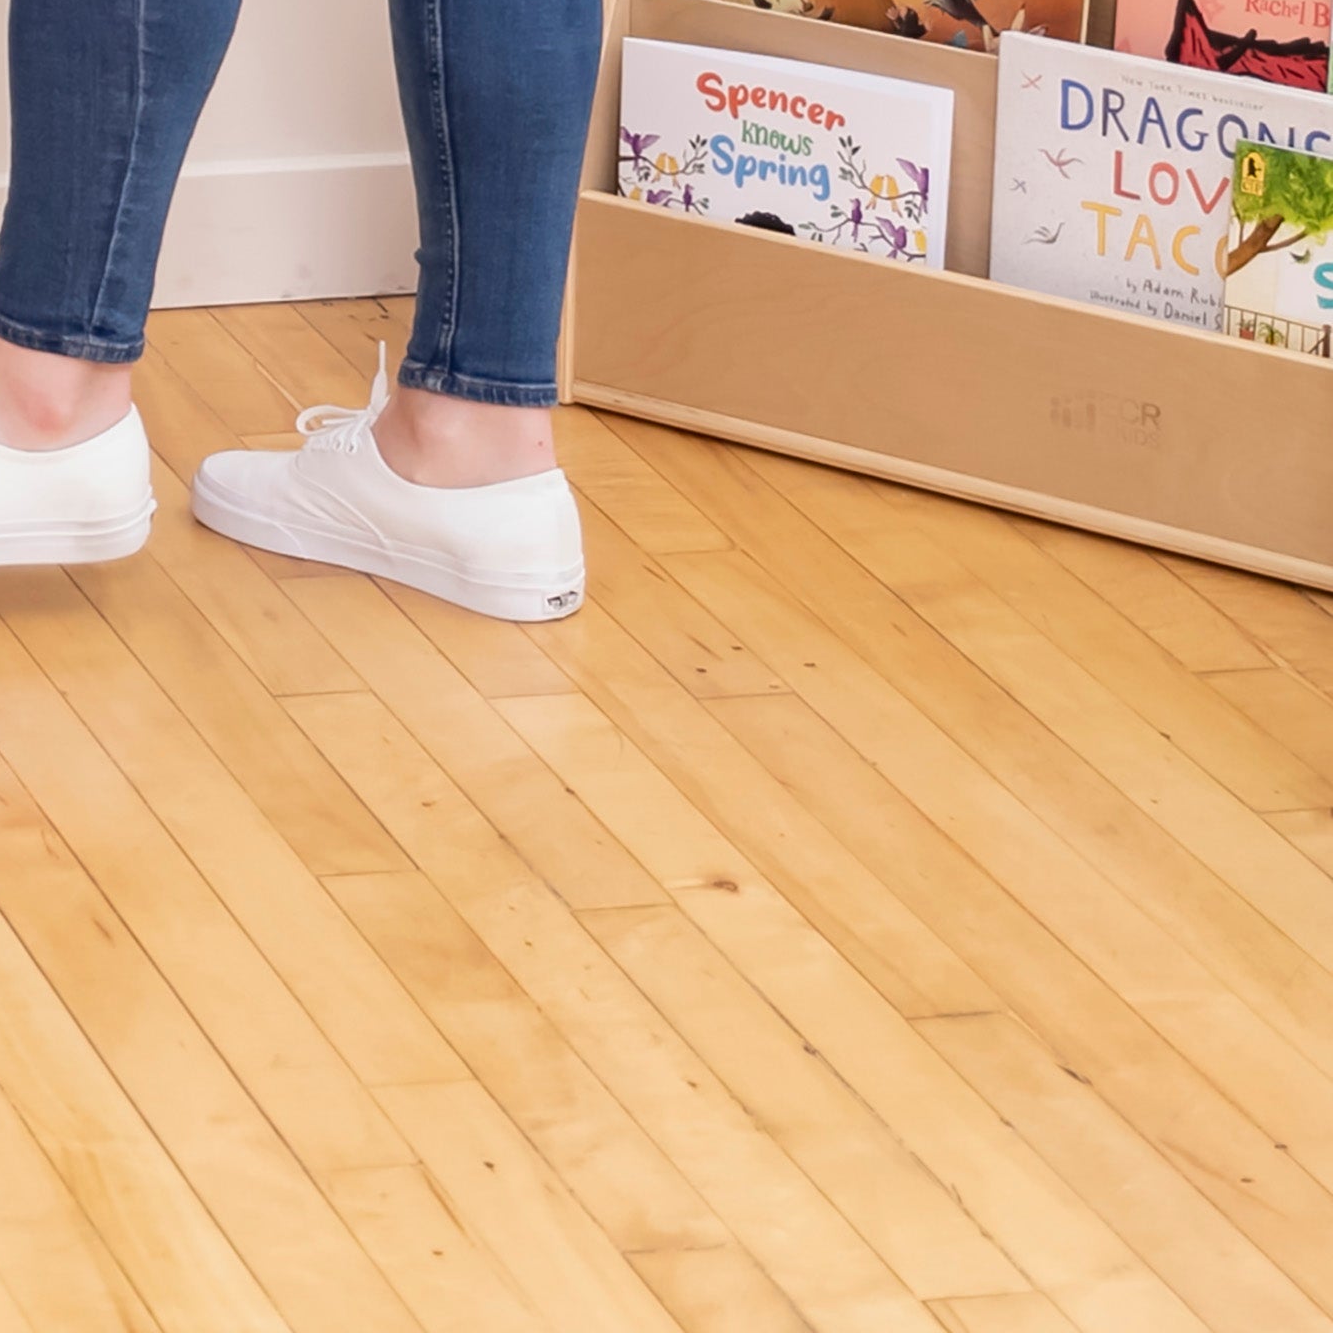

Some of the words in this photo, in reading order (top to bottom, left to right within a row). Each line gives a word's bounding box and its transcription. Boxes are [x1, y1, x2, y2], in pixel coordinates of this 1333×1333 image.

[696, 72, 845, 131] Spencer
[710, 134, 830, 201] Spring
[1143, 279, 1184, 299] Adam
[1164, 301, 1207, 325] Daniel
